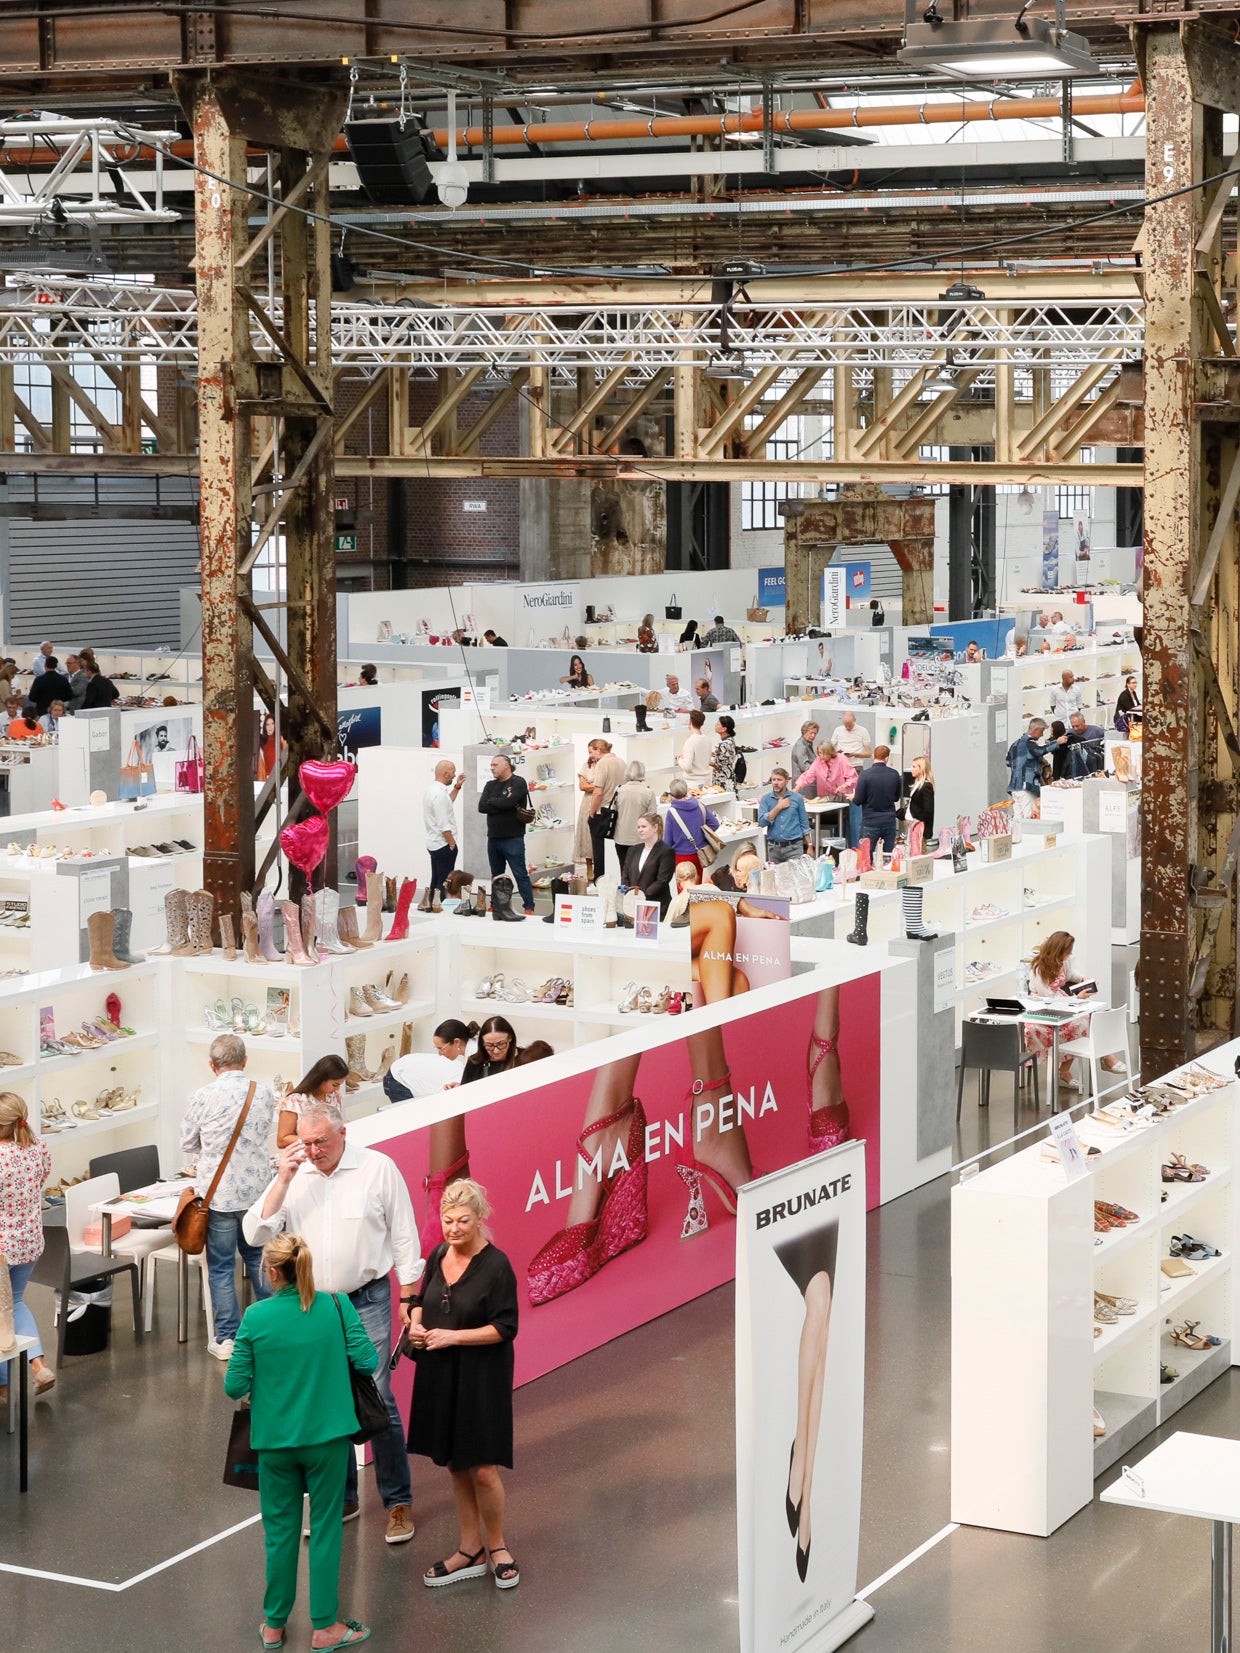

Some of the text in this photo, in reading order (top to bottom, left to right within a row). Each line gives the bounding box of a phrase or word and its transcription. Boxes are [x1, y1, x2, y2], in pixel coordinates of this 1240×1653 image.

[523, 591, 573, 608] NeroGiardini
[829, 571, 840, 625] NeroGiardini
[703, 950, 781, 966] ALMA EN PENA
[524, 1079, 779, 1213] ALMA EN PENA
[755, 1173, 852, 1231] BRUNATE
[780, 1613, 813, 1647] Handmade
[819, 1599, 832, 1615] Italy
